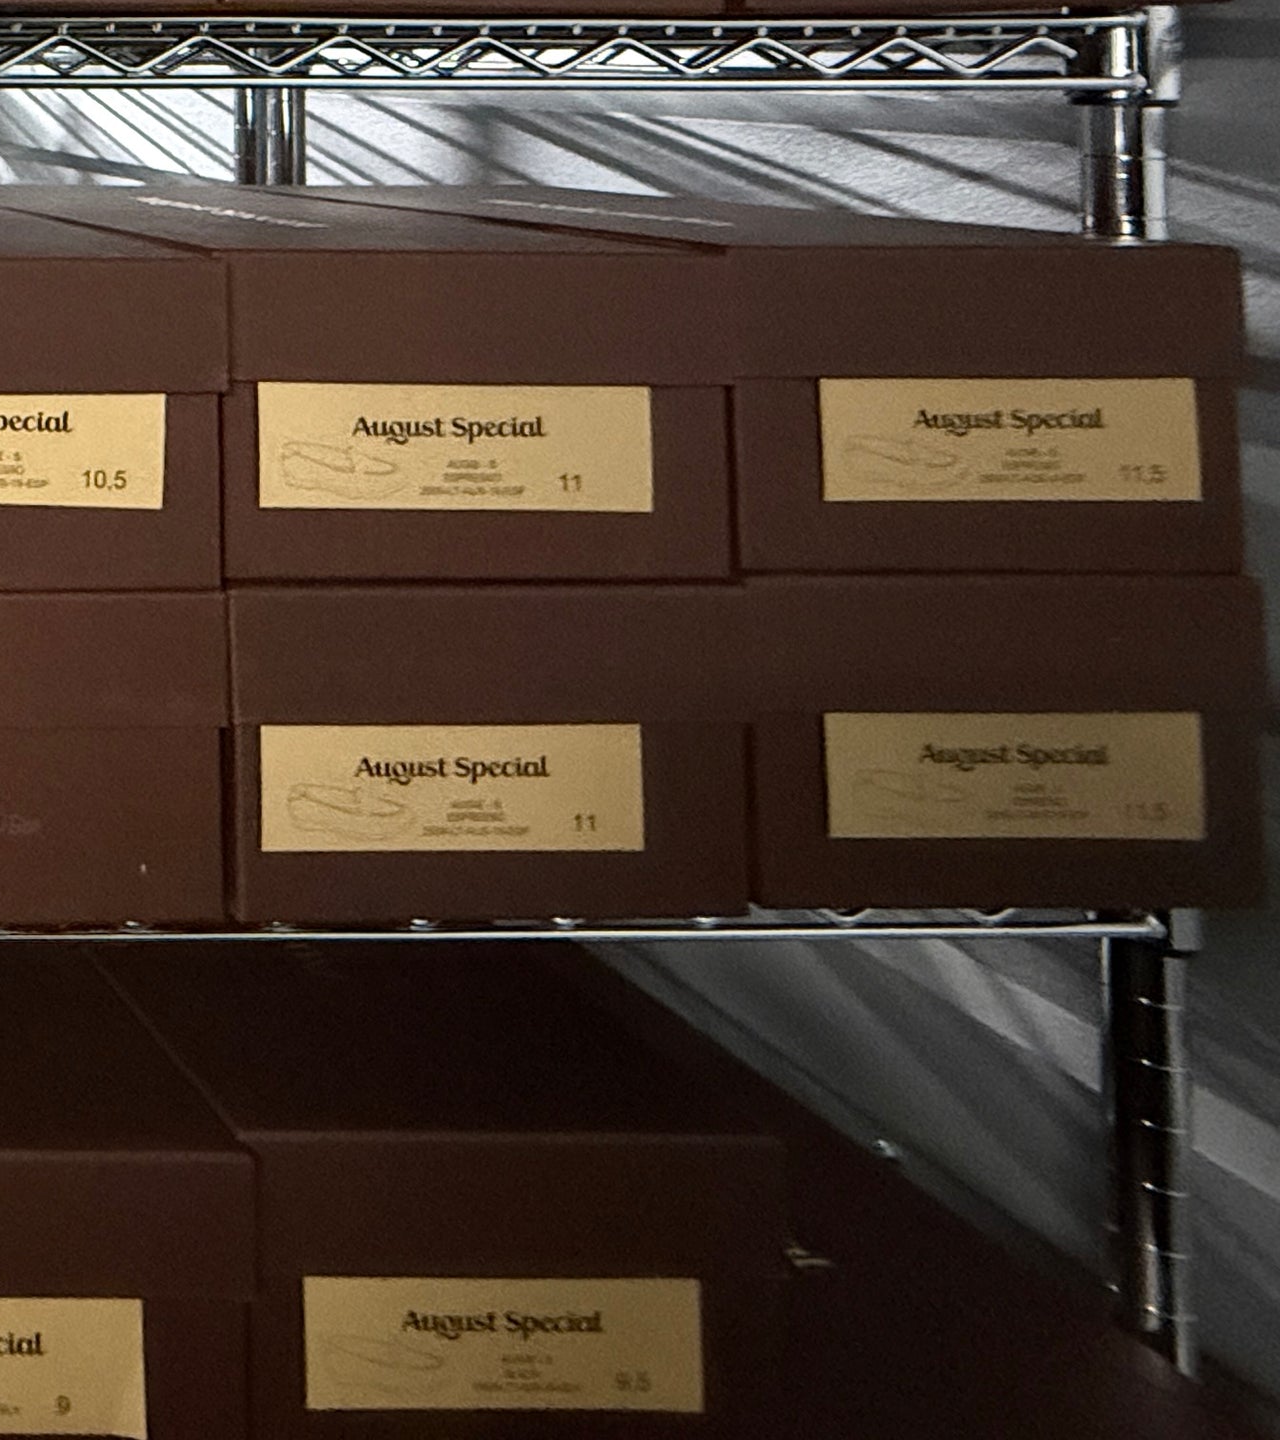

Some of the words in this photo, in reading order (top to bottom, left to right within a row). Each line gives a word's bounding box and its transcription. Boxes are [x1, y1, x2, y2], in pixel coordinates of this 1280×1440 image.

[352, 417, 445, 445] August
[451, 416, 546, 444] Special
[913, 409, 1006, 437] August
[1010, 408, 1105, 436] Special
[559, 473, 581, 491] 11
[354, 757, 447, 786] August
[454, 756, 550, 784] Special
[574, 814, 596, 831] 11
[402, 1310, 498, 1340] August
[503, 1311, 603, 1341] Special
[56, 1395, 71, 1416] 9
